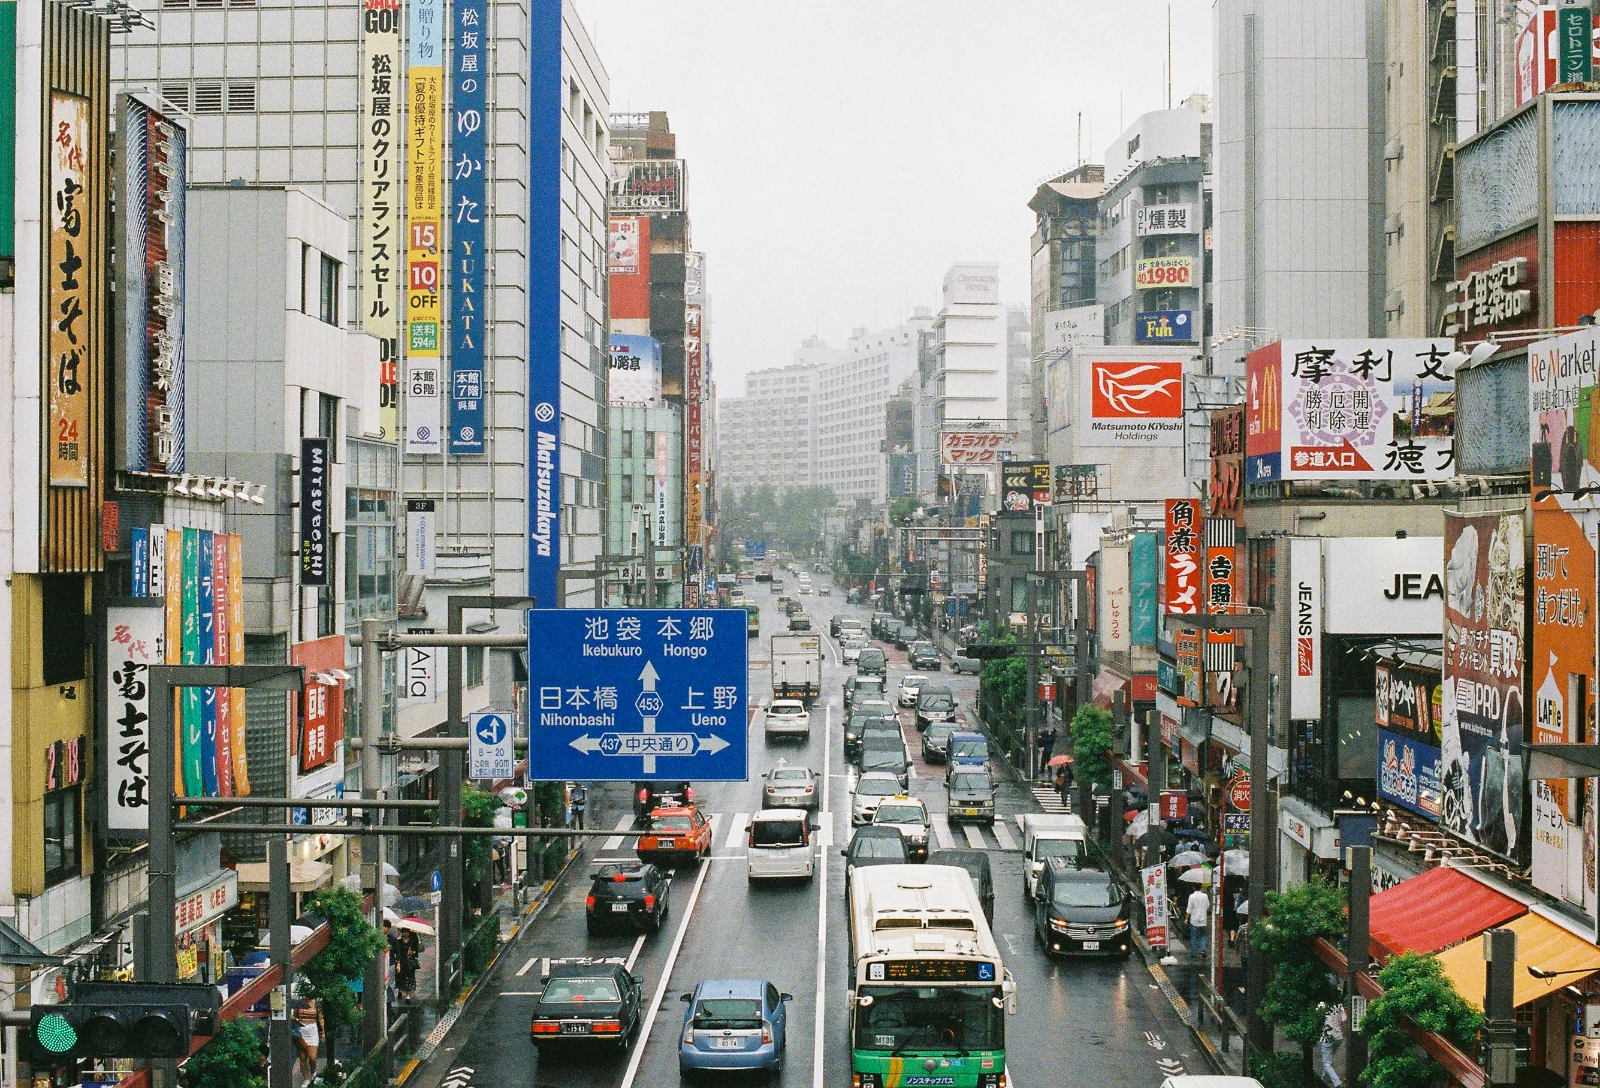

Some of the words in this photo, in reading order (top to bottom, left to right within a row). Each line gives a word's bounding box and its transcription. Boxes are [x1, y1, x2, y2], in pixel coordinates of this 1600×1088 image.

[365, 9, 399, 33] GO!
[55, 121, 84, 173] 名代
[370, 54, 391, 318] 松坂屋のクリアランスセール
[1147, 267, 1190, 285] 1980
[56, 178, 87, 395] 富士そば
[461, 241, 475, 349] YUKATA
[411, 296, 437, 308] OFF
[412, 325, 435, 336] 送料
[1146, 321, 1173, 338] Fun
[412, 338, 435, 348] 594円
[413, 371, 434, 382] 本館
[457, 372, 479, 383] 本館
[413, 384, 434, 395] 6階
[457, 385, 479, 397] 7階
[1305, 390, 1322, 430] 勝利
[1329, 391, 1347, 430] 厄除
[1353, 390, 1370, 430] 開運
[59, 418, 78, 441] 24
[1091, 422, 1147, 431] Matsumoto
[946, 434, 1003, 448] カラオケ
[1115, 432, 1158, 441] Holdings
[1294, 451, 1355, 468] 参道入口
[532, 431, 556, 557] Matsuzakaya
[1536, 543, 1569, 580] 預けて
[1298, 581, 1313, 636] JEANS
[585, 616, 642, 641] 池袋
[657, 616, 714, 641] 本郷
[582, 643, 643, 657] Ikebukuro
[663, 643, 708, 658] Hongo
[411, 647, 431, 697] Aria
[540, 686, 618, 710] 日本橋
[680, 686, 738, 710] 上野
[638, 697, 660, 711] 453
[540, 712, 615, 726] Nihonbashi
[691, 712, 727, 726] Ueno
[601, 737, 620, 750] 437
[625, 736, 690, 751] 中央通り
[1233, 789, 1250, 801] 消火
